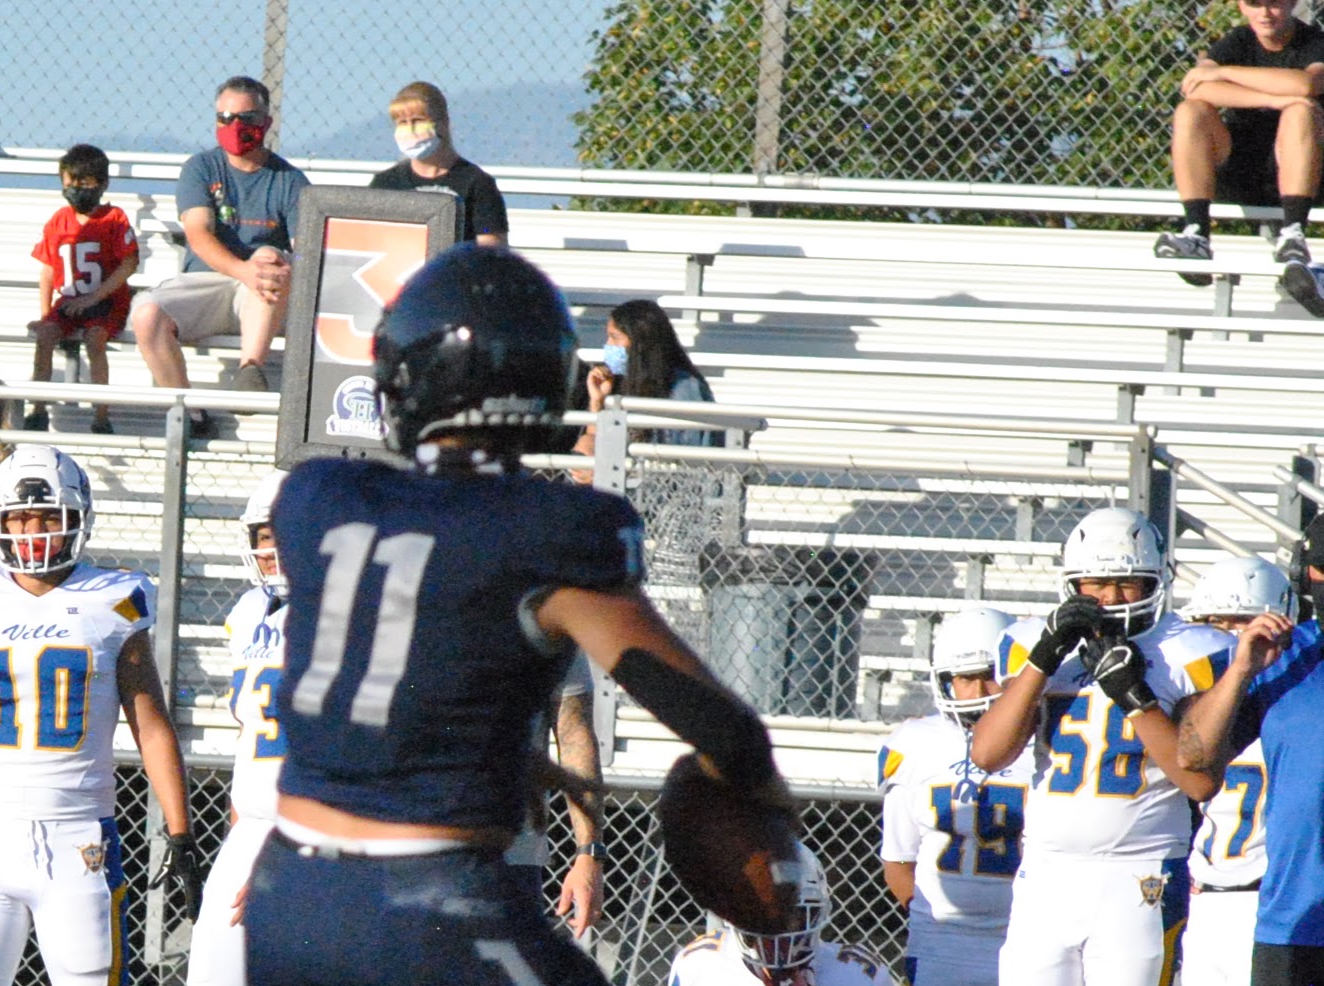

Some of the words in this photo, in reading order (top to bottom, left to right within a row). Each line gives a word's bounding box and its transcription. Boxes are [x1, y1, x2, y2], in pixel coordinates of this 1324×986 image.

[58, 242, 102, 296] 15
[1, 623, 72, 641] Ville
[291, 521, 436, 727] 11
[1044, 691, 1148, 800] 58
[929, 780, 1029, 876] 19
